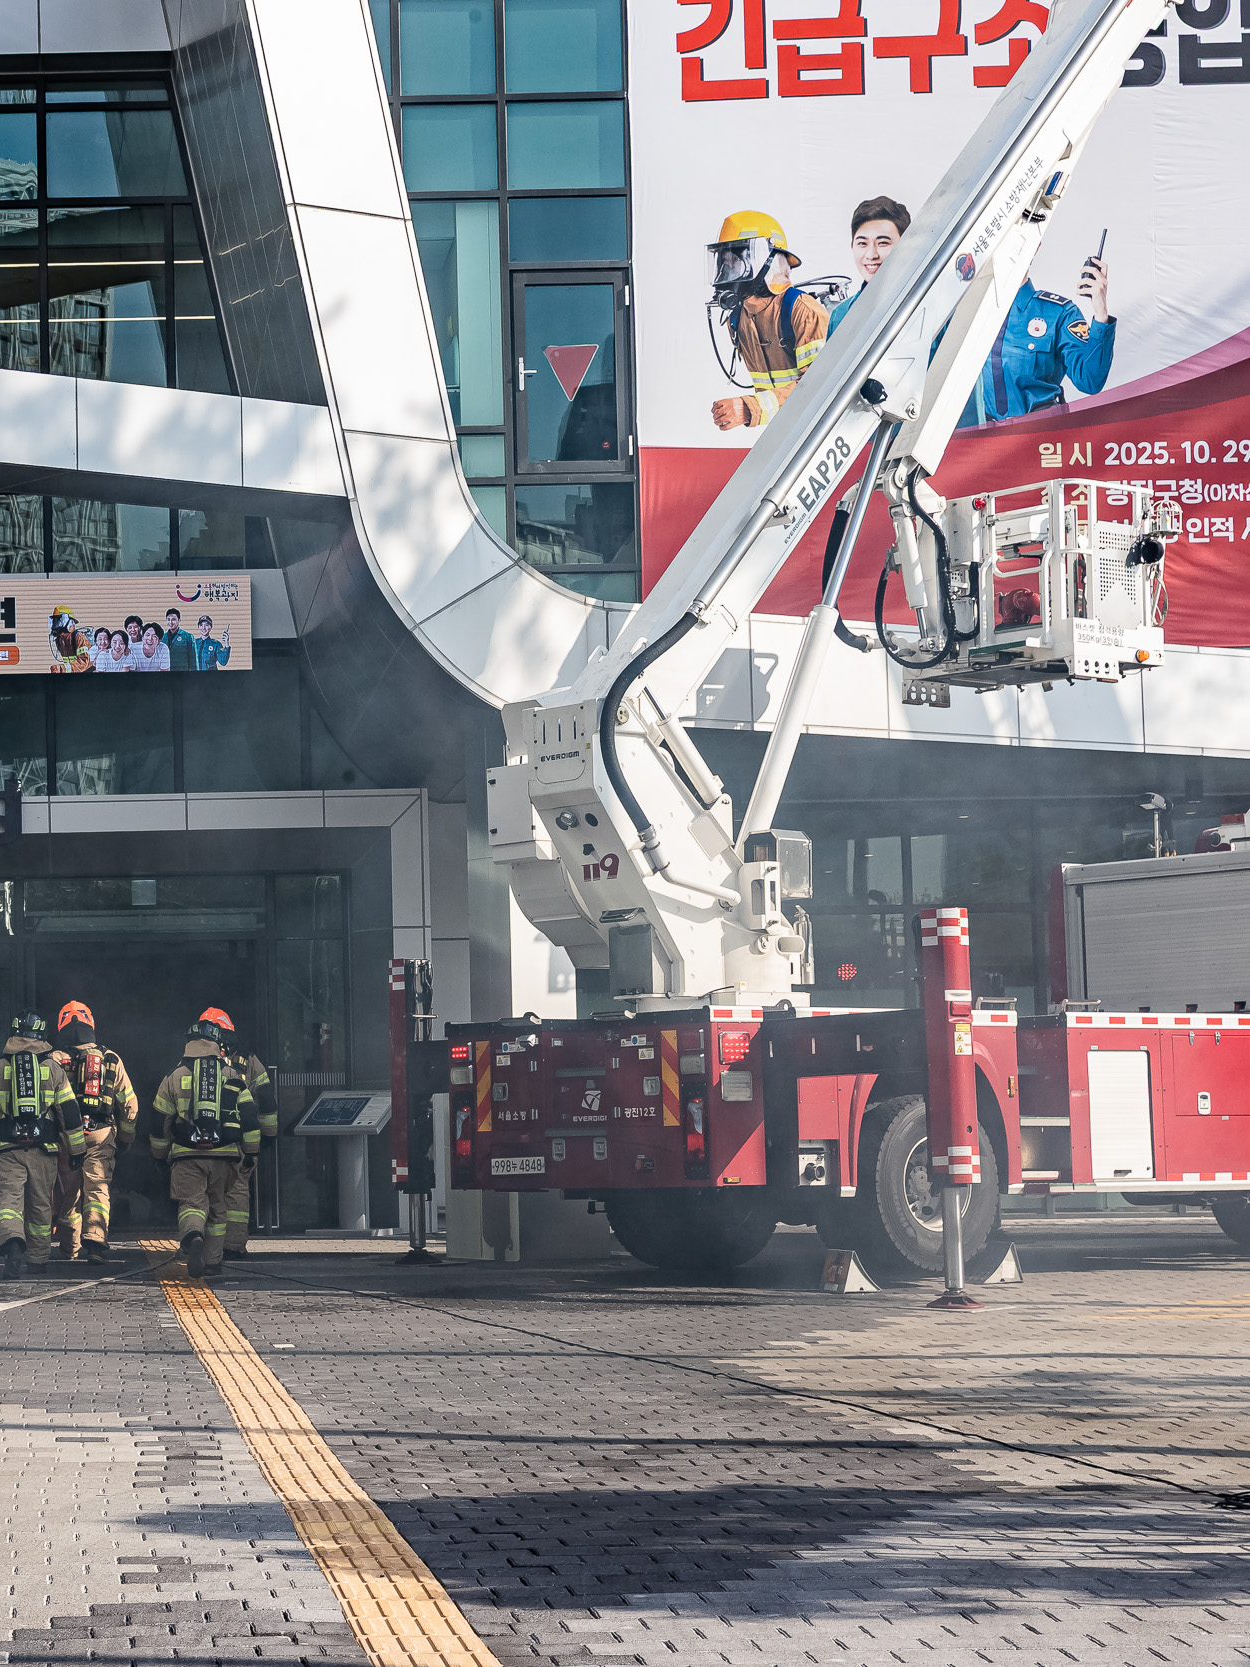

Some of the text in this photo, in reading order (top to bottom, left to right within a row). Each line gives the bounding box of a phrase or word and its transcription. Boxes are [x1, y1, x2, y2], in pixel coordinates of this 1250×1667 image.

[972, 156, 1044, 257] 서울특별시 소방재난본부
[1104, 441, 1176, 466] 2025.
[1180, 440, 1217, 464] 10.
[796, 436, 851, 513] EAP28
[204, 589, 239, 602] 행복광진
[581, 853, 620, 883] 119
[497, 1110, 527, 1121] 서울소방
[624, 1106, 656, 1118] 광진12호
